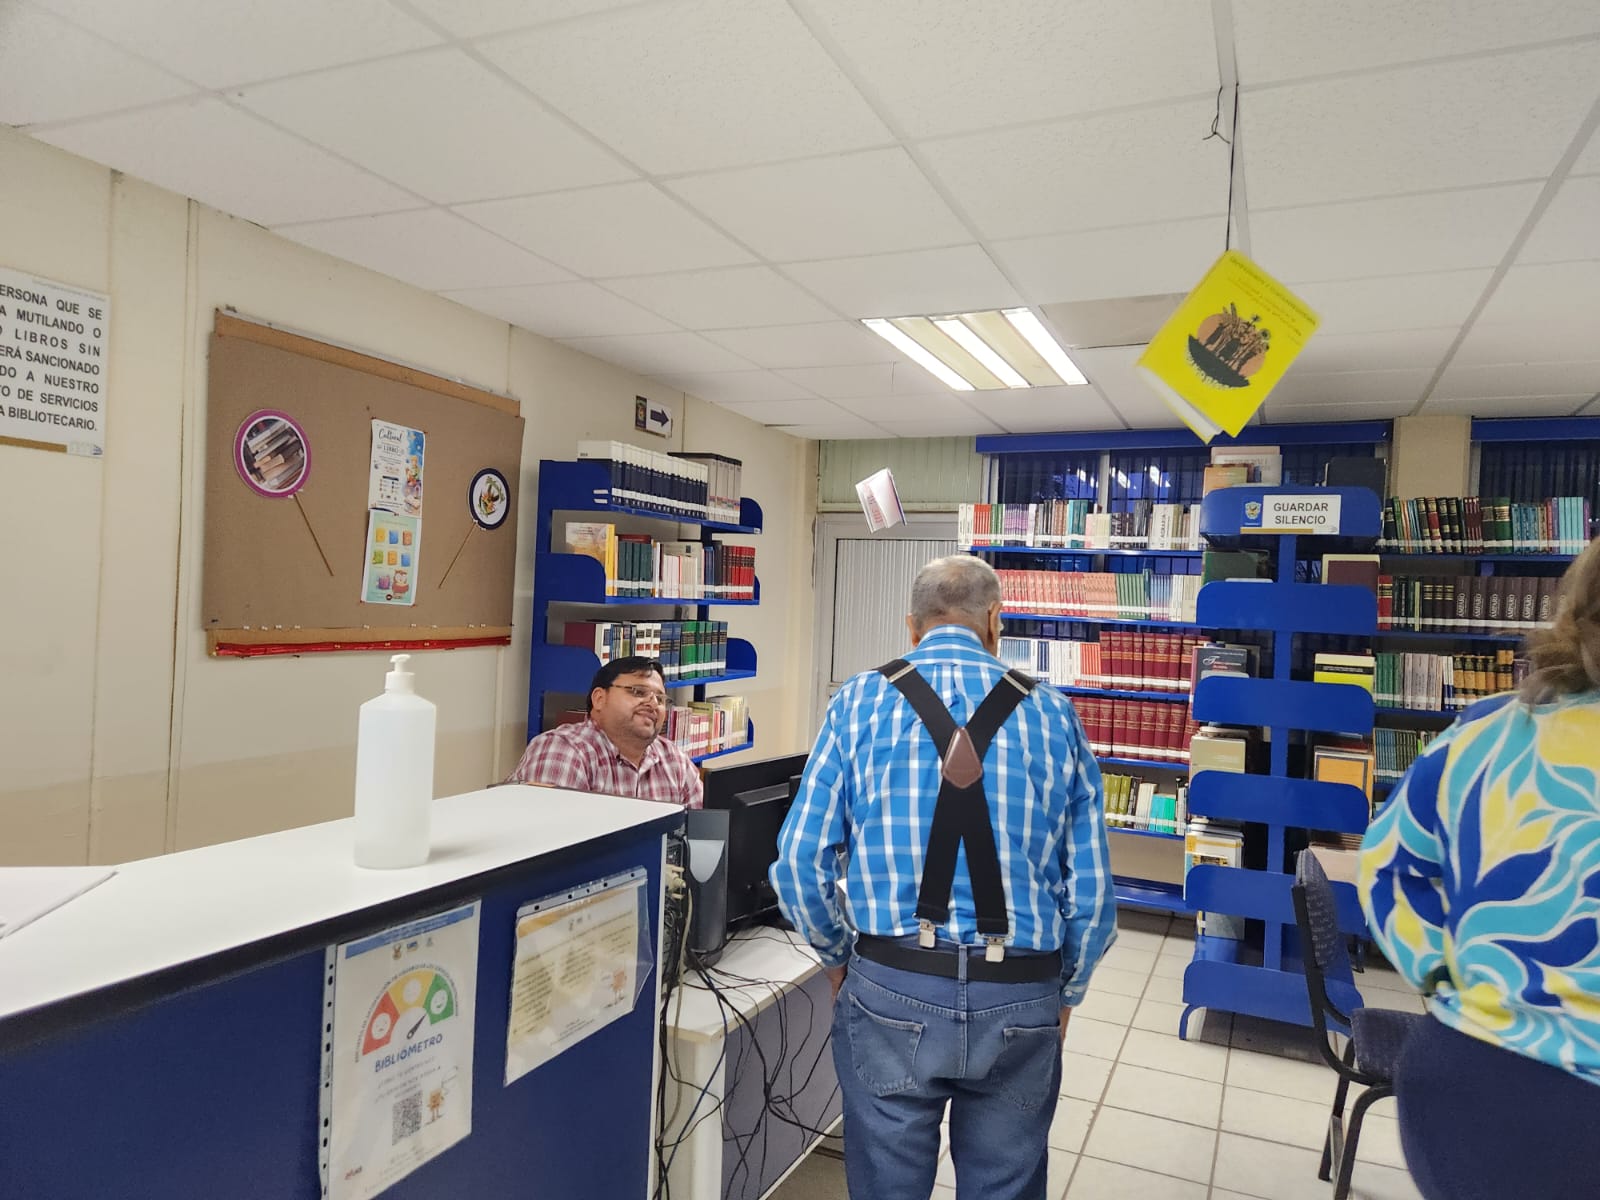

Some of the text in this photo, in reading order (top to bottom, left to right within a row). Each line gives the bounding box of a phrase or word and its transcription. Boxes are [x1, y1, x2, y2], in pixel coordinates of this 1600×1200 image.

[56, 299, 80, 315] QUE
[88, 307, 102, 320] SE
[16, 309, 84, 335] MUTILANDO
[93, 327, 101, 338] O
[15, 328, 68, 350] LIBROS
[79, 343, 100, 357] SIN
[26, 351, 99, 375] SANCIONADO
[26, 371, 35, 381] A
[44, 374, 99, 394] NUESTRO
[18, 388, 33, 401] DE
[40, 393, 98, 412] SERVICIOS
[8, 407, 97, 431] BIBLIOTECARIO.
[1273, 502, 1329, 512] GUARDAR
[1275, 515, 1326, 525] SILENCIO
